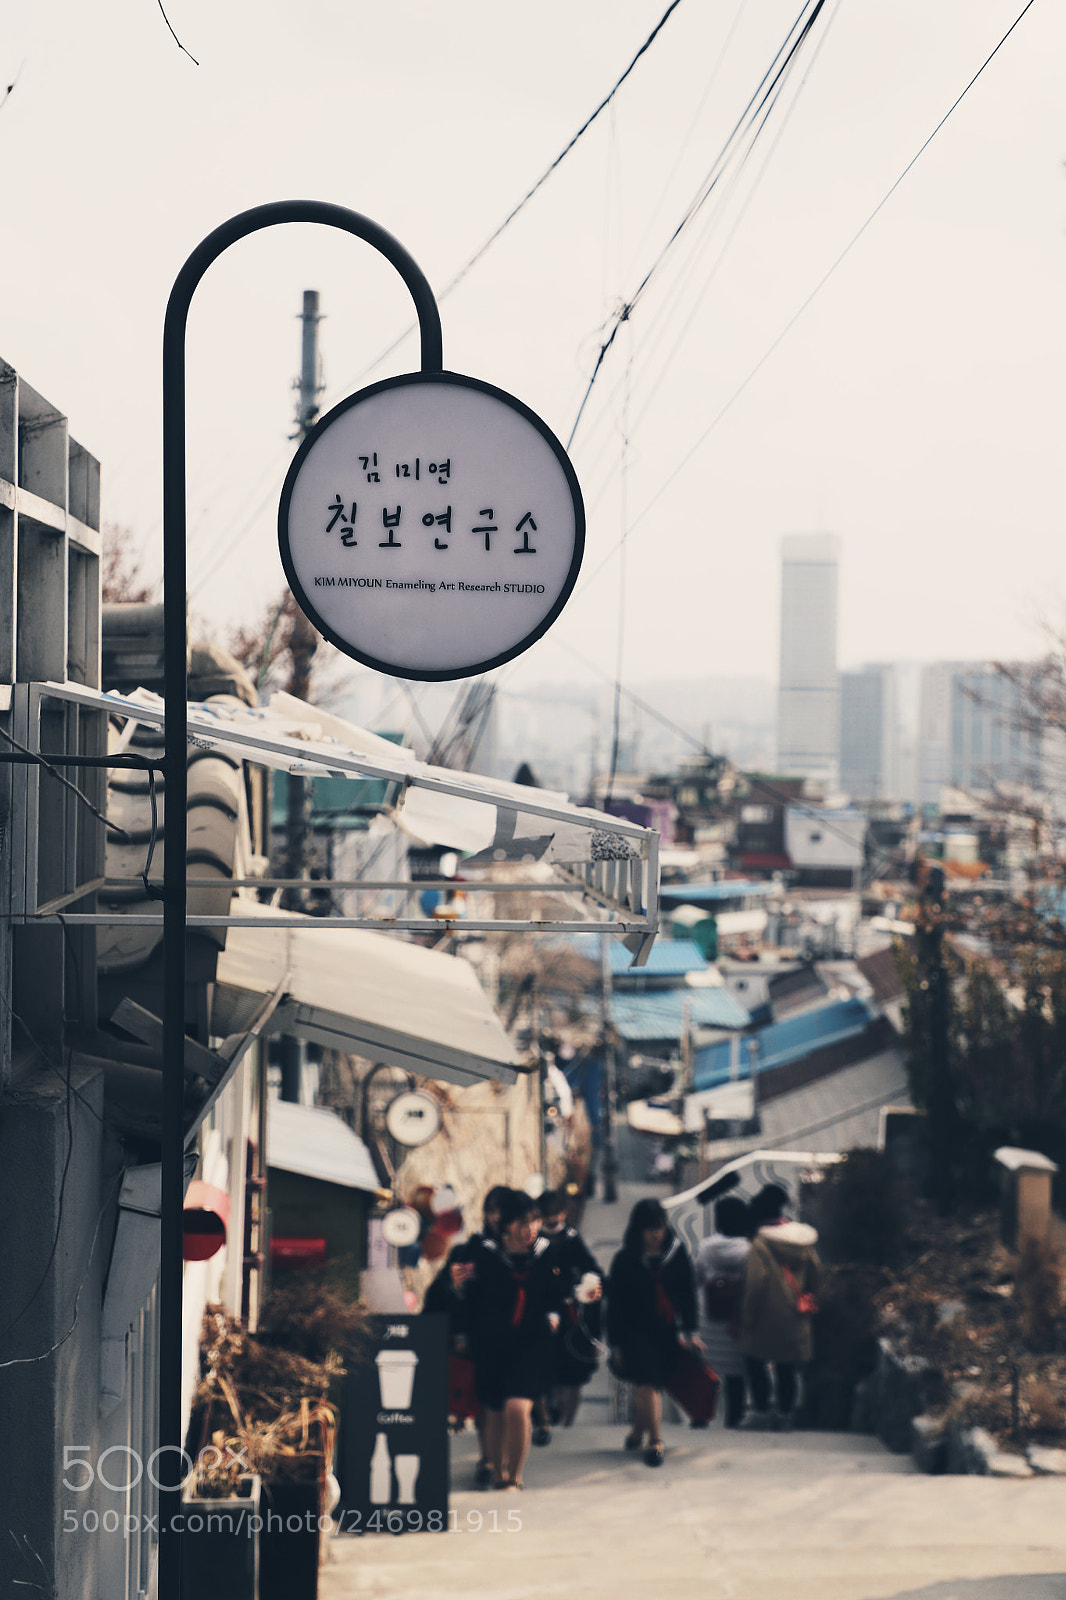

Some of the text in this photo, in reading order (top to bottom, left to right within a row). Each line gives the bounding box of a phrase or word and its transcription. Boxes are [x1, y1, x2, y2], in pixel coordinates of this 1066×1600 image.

[325, 494, 538, 554] 칠보연구소
[314, 576, 546, 594] KIM MIYOUN Enameling Art Research STUDIO
